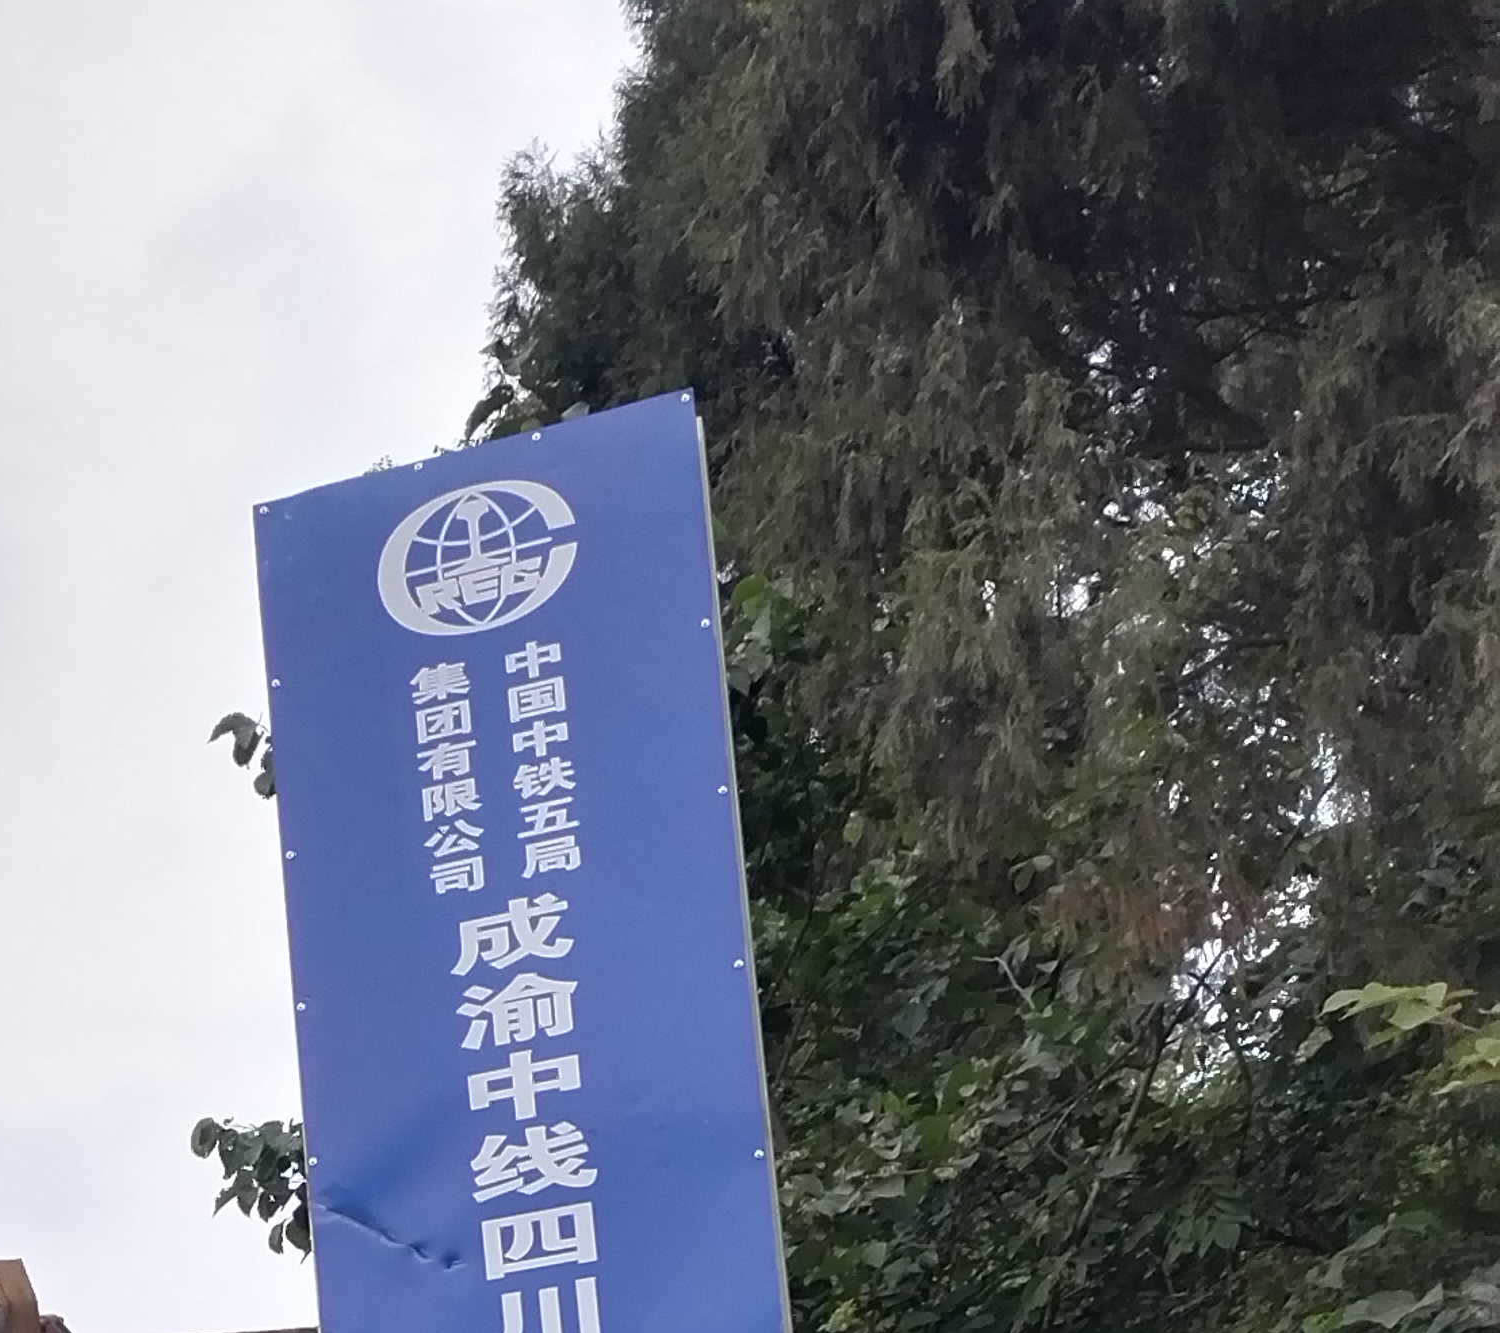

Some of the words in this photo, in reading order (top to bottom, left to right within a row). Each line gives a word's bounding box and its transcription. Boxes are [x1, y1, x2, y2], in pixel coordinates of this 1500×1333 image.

[410, 662, 484, 894] 集团有限公司
[505, 641, 581, 878] 中国中铁五局
